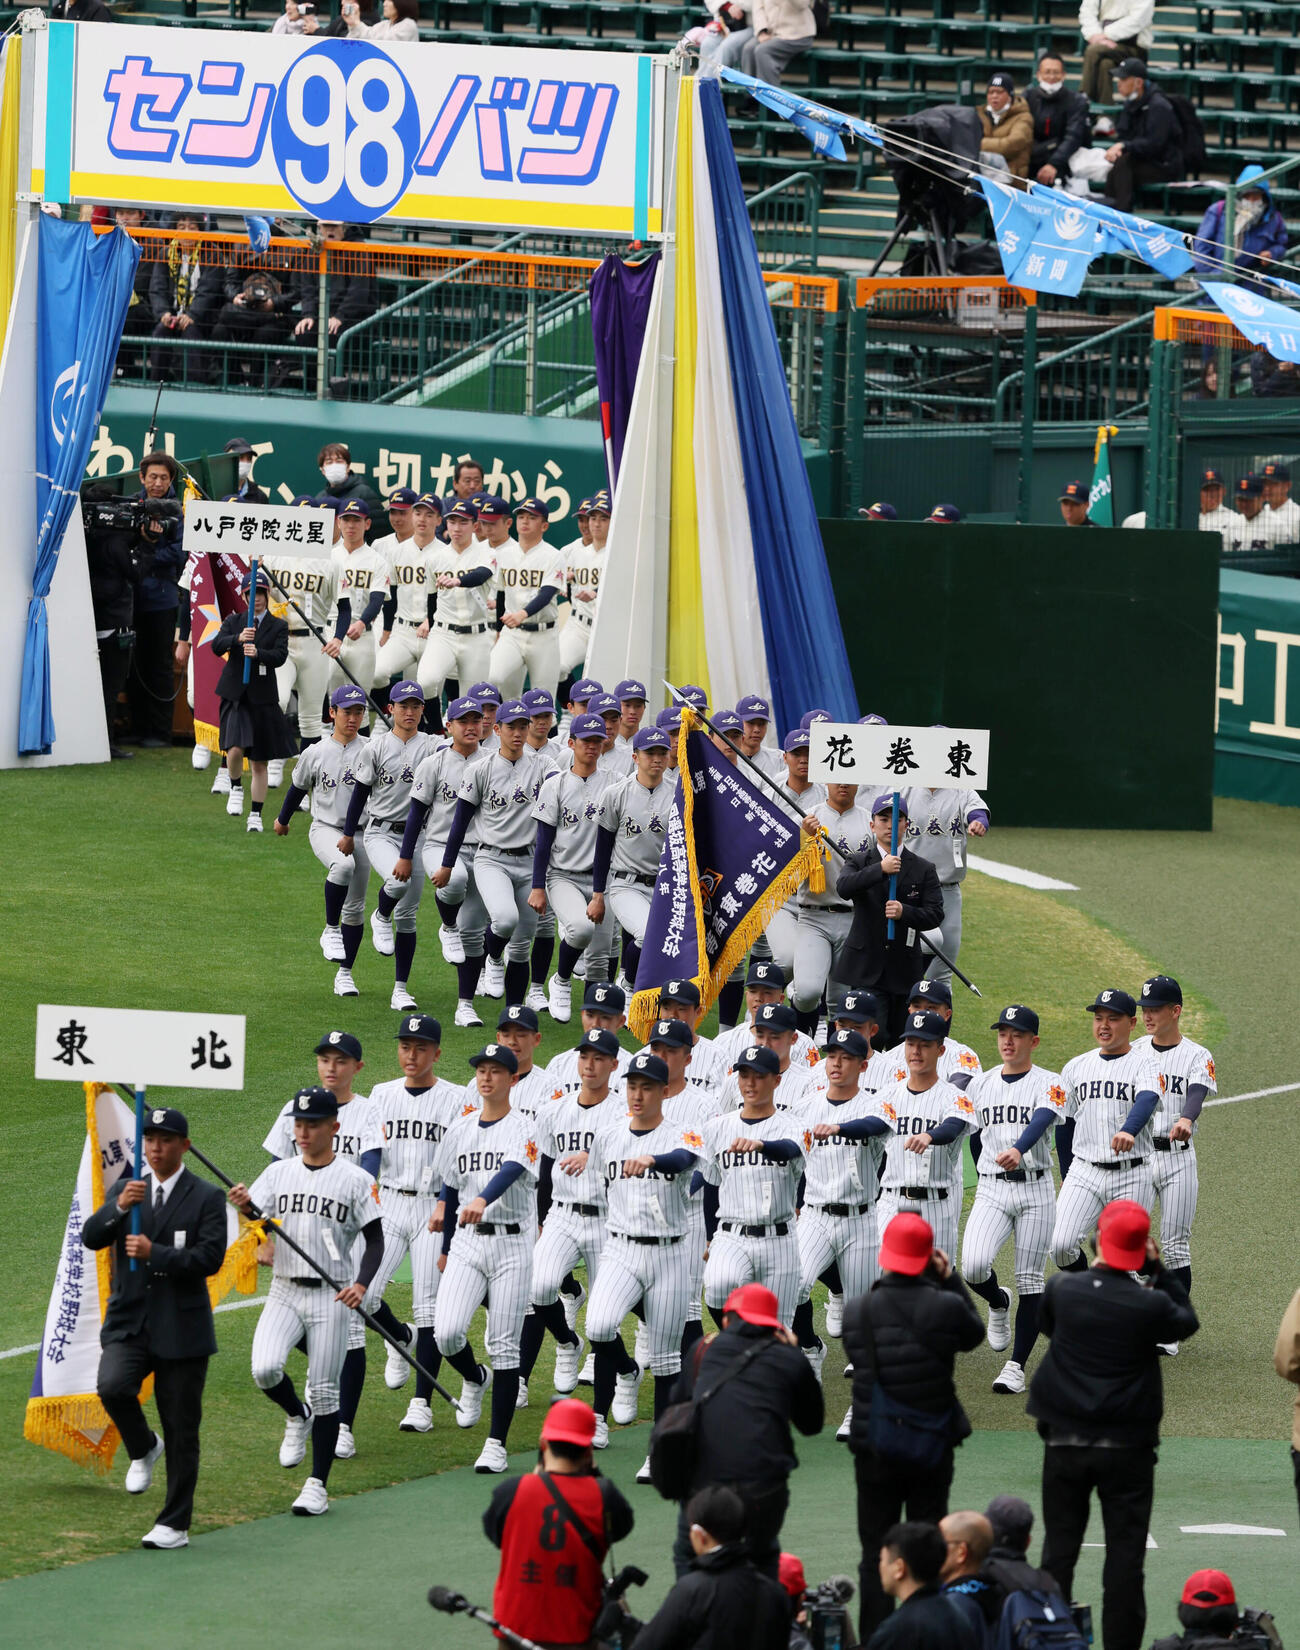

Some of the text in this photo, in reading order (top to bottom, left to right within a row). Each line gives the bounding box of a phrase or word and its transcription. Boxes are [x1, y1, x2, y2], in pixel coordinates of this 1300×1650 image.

[104, 54, 619, 207] セン 98 バツ
[194, 516, 325, 545] 八戸学院光星
[820, 734, 977, 778] 花巻東
[52, 1019, 231, 1069] 東北
[279, 1193, 349, 1224] OHOKU
[539, 1503, 567, 1551] 8
